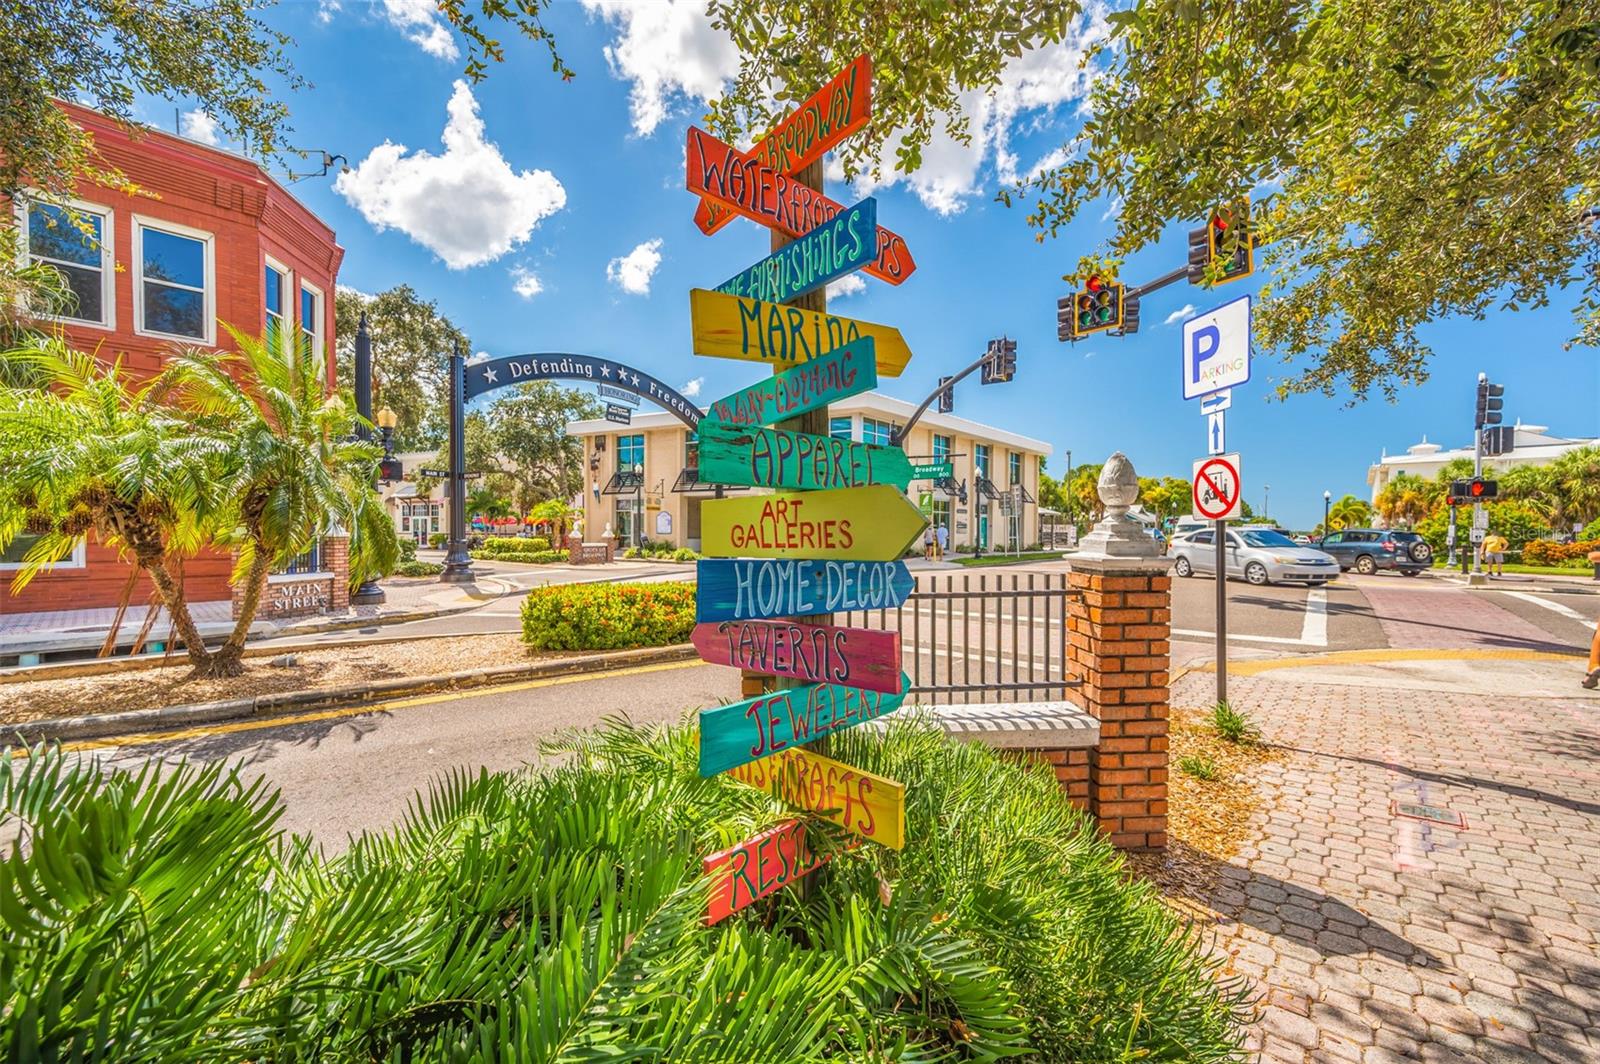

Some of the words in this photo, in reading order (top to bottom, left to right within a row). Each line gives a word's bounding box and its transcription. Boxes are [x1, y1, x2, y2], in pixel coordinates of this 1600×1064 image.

[766, 64, 857, 173] BROADWAY
[509, 358, 593, 378] Defending
[649, 381, 700, 426] Freedom
[751, 429, 881, 488] APPAREL
[915, 466, 944, 474] Broadway
[760, 500, 803, 523] ART
[730, 519, 853, 549] GALLERIES
[282, 583, 321, 597] MAIN
[734, 560, 813, 618] HOME
[825, 560, 901, 611] DECOR
